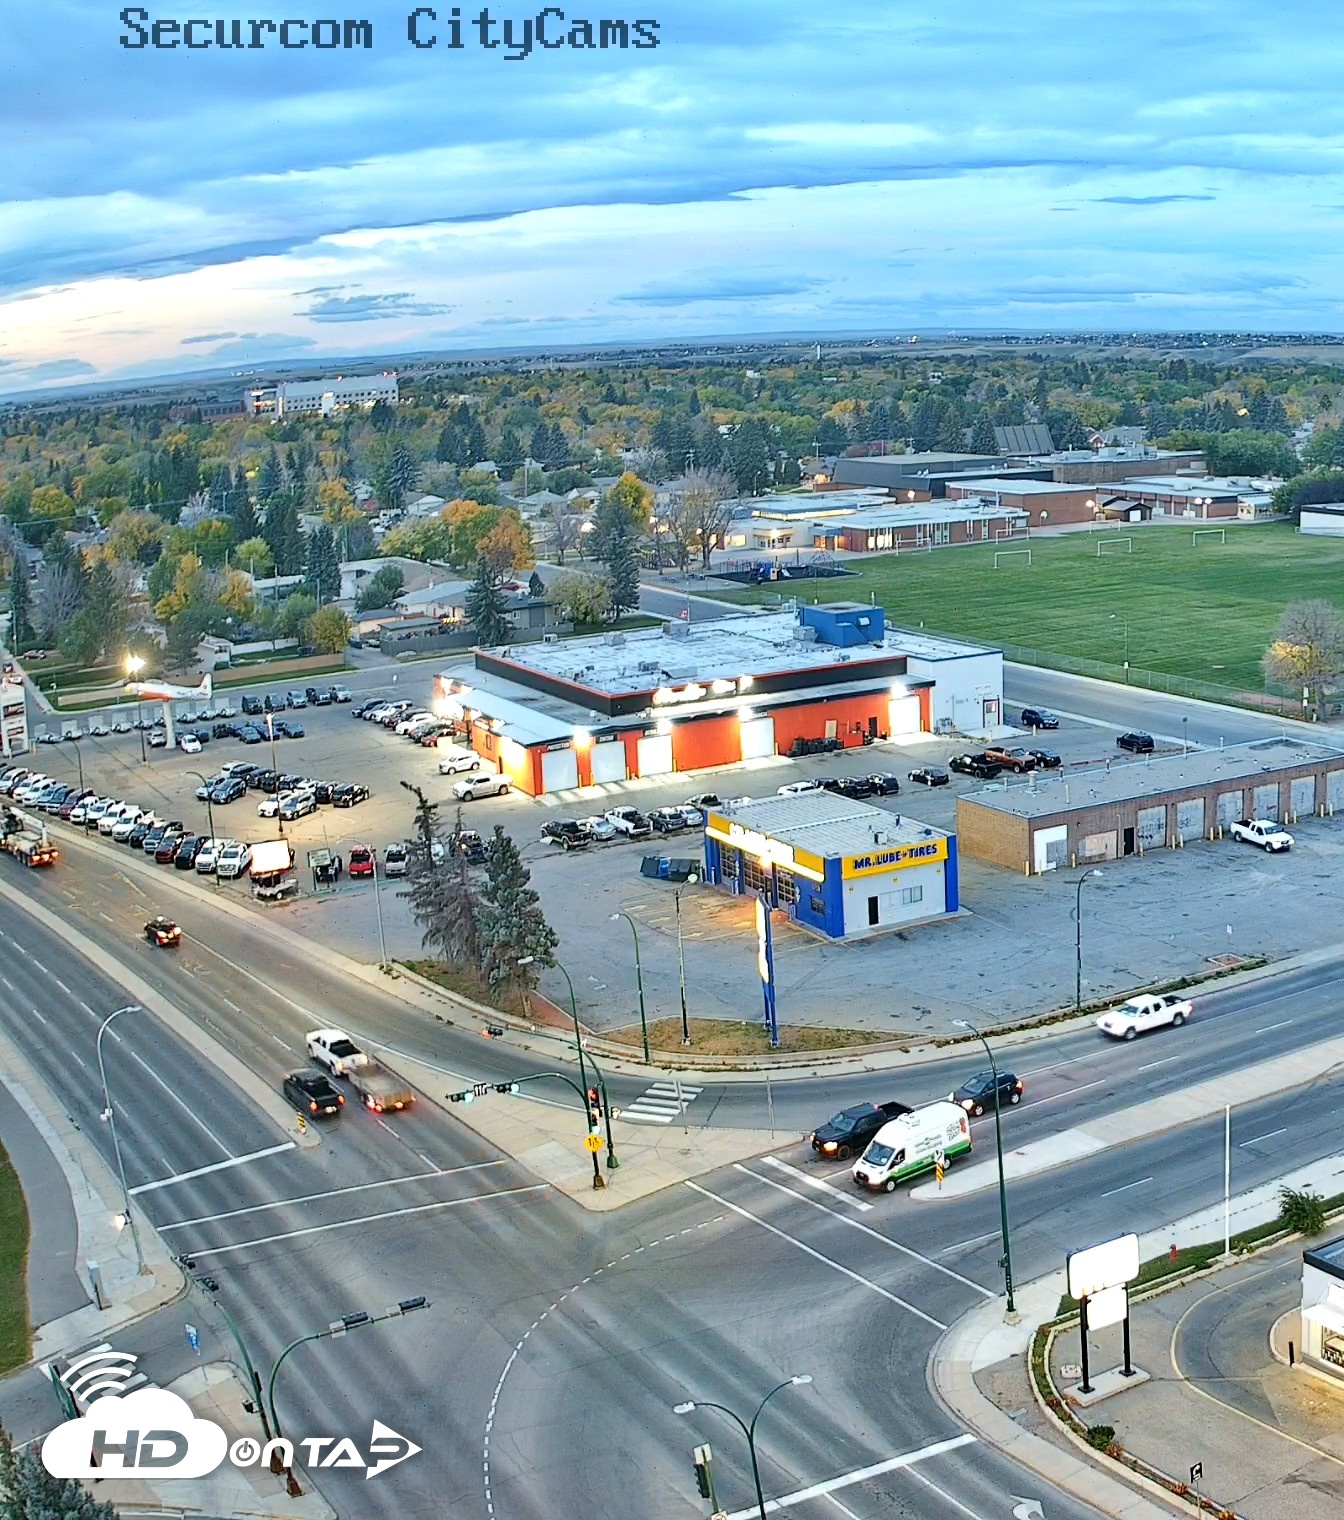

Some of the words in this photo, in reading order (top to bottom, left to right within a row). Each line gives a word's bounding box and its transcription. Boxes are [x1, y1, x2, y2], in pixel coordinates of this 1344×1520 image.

[854, 857, 875, 870] MR.
[875, 850, 901, 865] LUBE
[907, 844, 938, 858] TIRES
